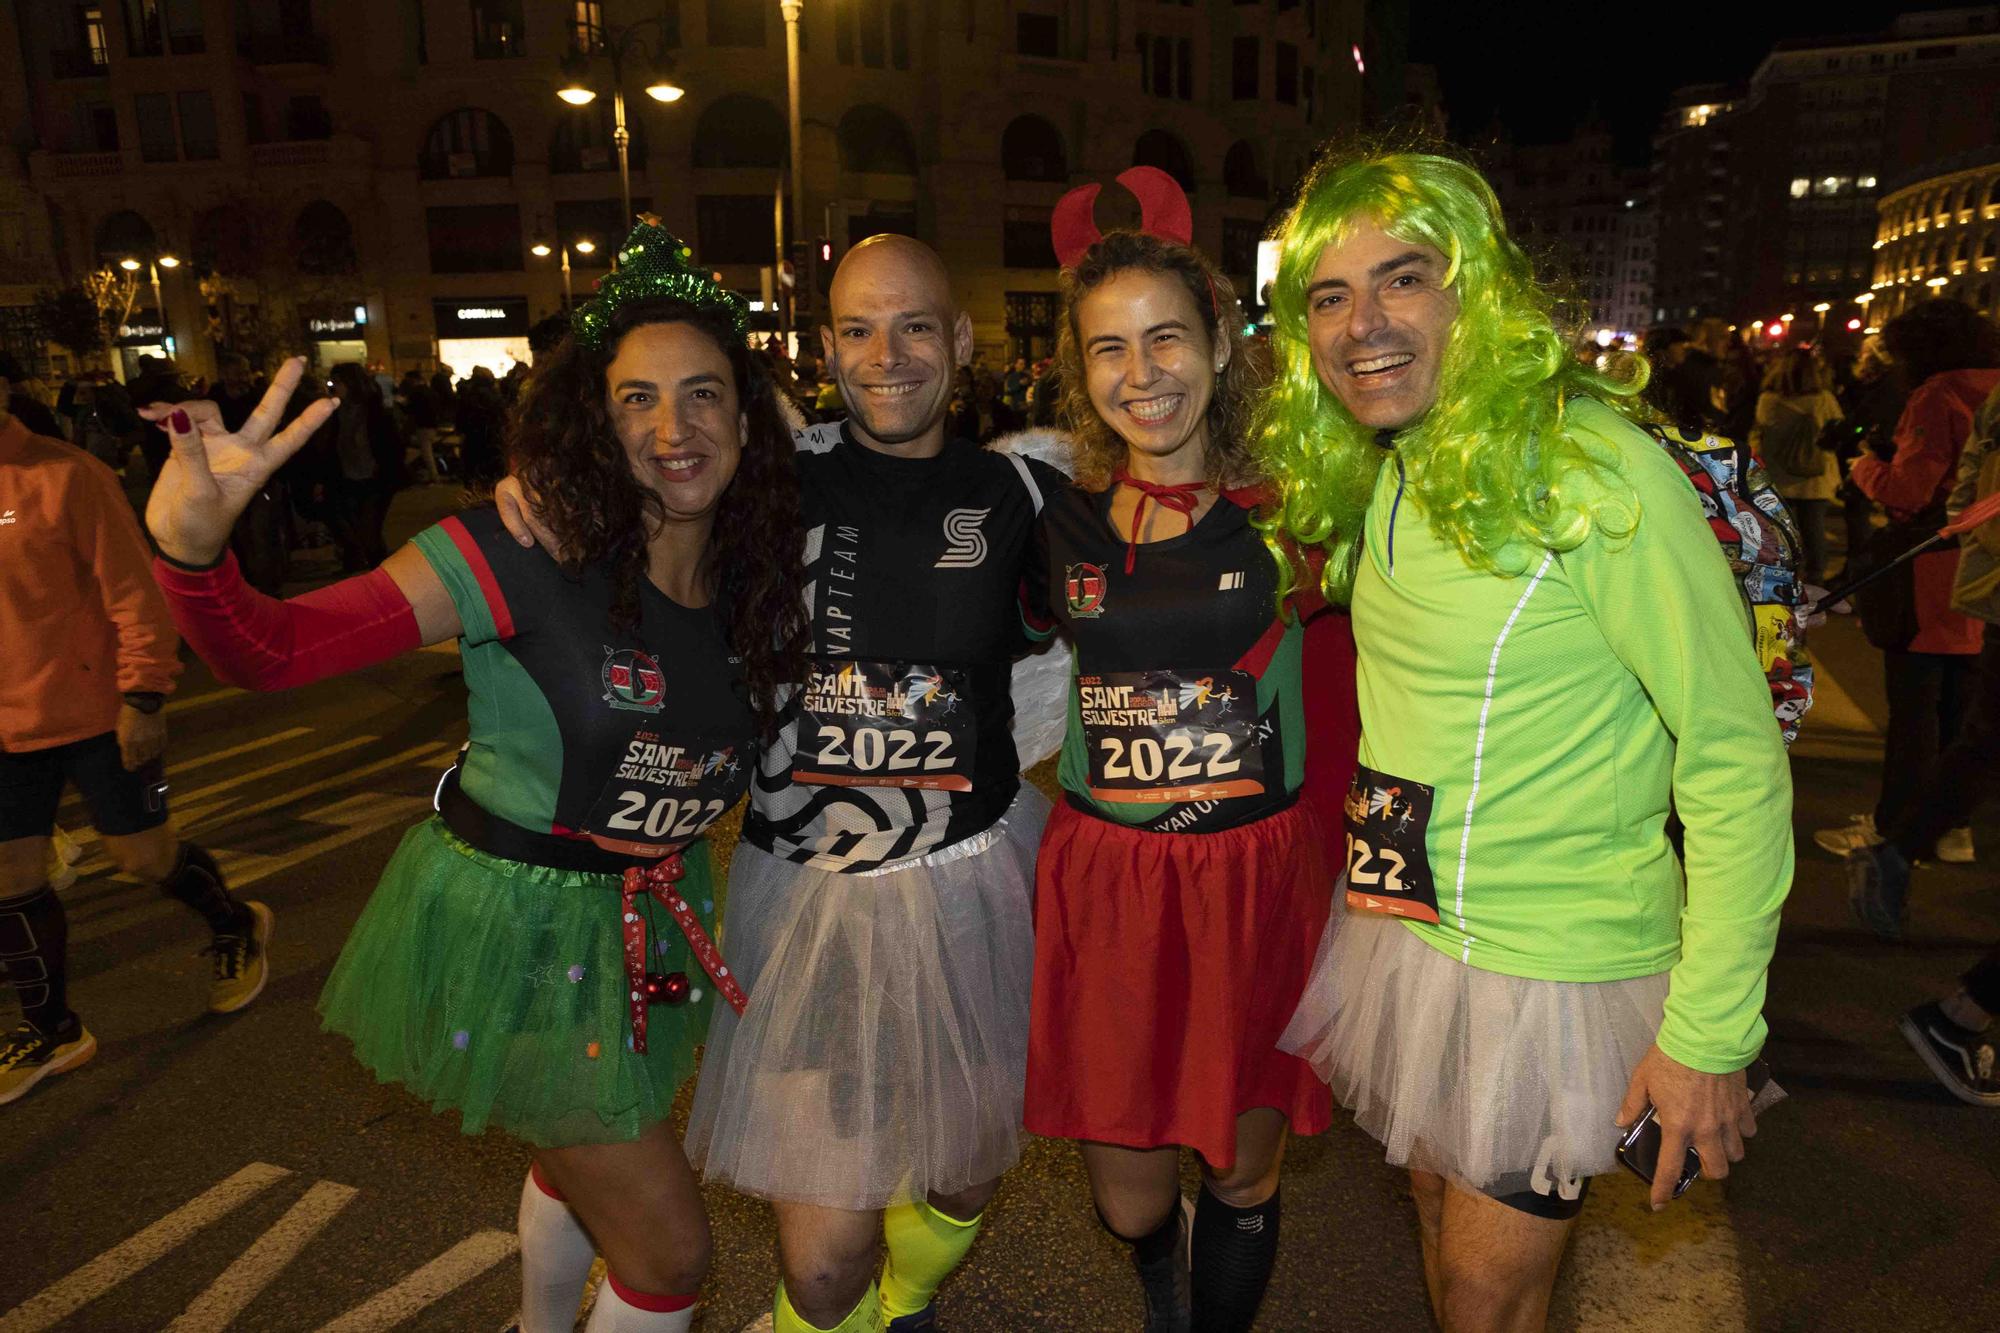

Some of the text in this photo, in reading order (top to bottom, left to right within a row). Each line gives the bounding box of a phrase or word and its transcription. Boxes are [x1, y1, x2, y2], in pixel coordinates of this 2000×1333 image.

[805, 673, 867, 697] SANT
[1080, 676, 1102, 685] 2022
[1081, 686, 1134, 709] SANT
[623, 740, 685, 769] SANT
[816, 725, 957, 771] 2022
[1100, 732, 1241, 782] 2022
[606, 790, 725, 838] 2022
[1154, 807, 1199, 832] YAN
